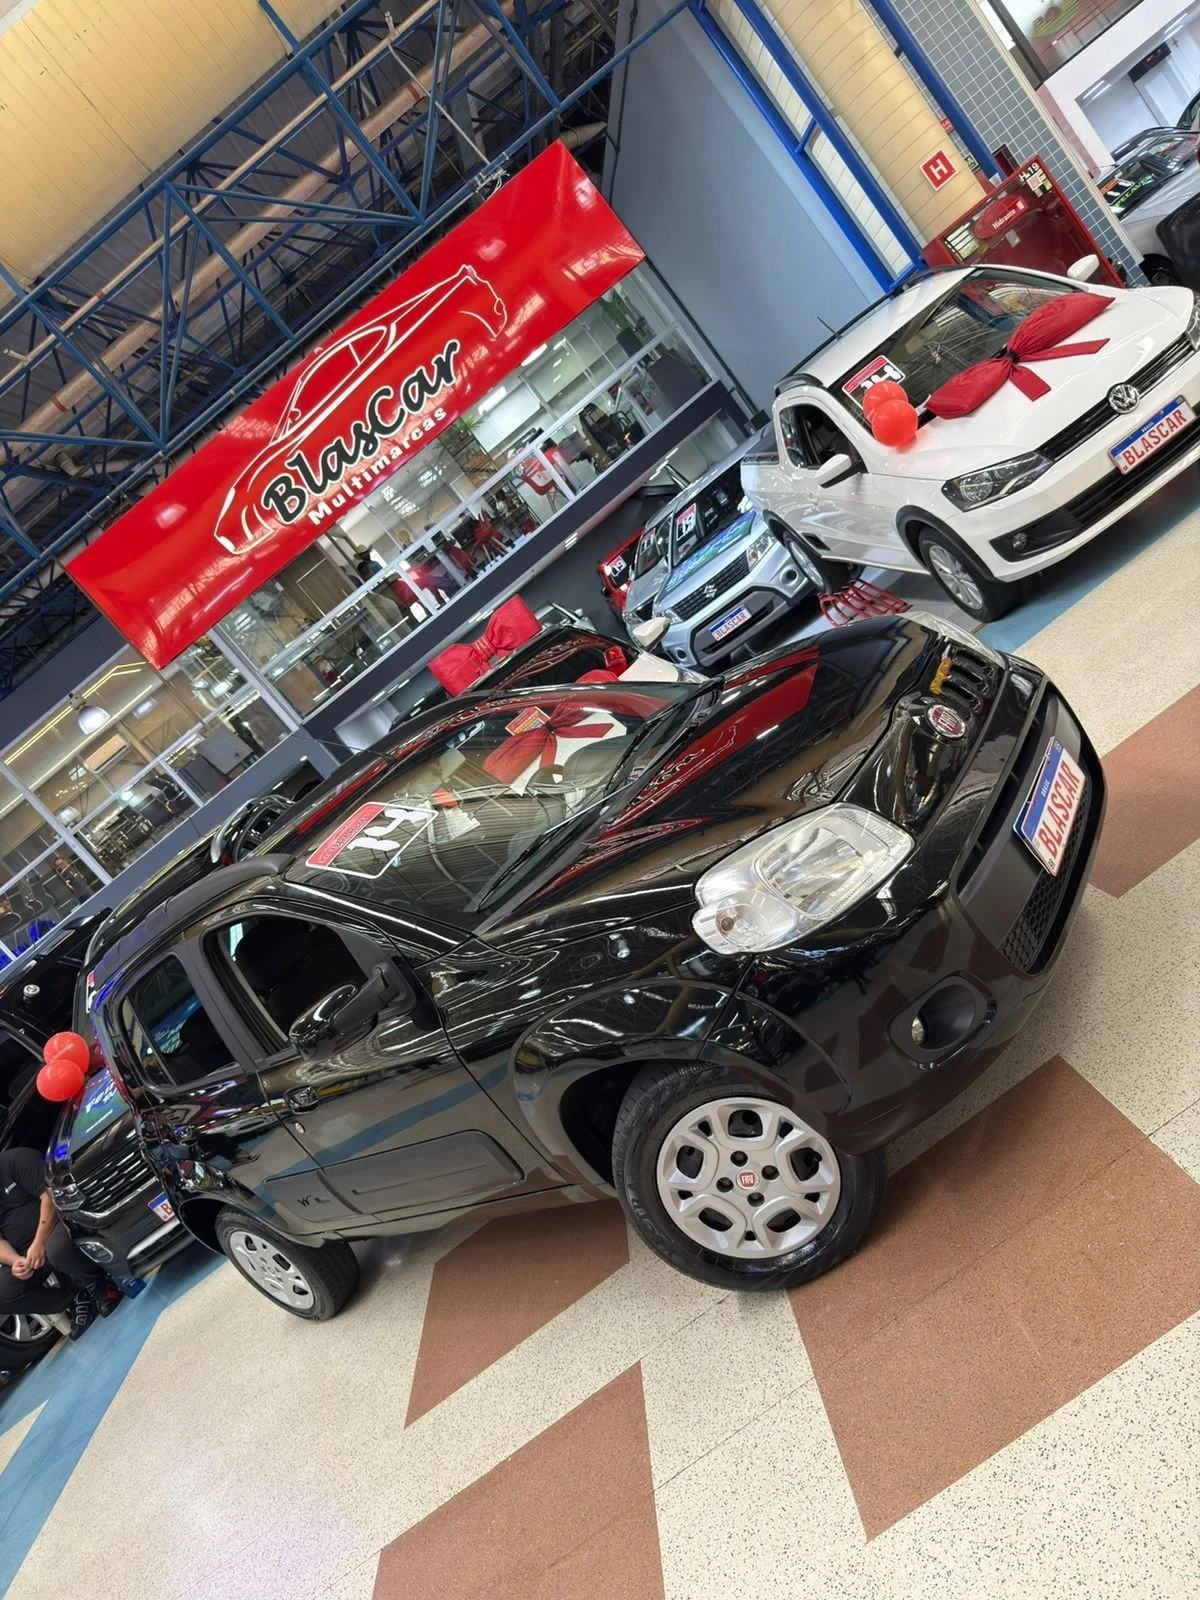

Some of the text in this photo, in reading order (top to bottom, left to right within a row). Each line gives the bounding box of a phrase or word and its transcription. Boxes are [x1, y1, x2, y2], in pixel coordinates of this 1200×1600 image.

[930, 158, 949, 181] H
[992, 208, 1017, 230] Hidrante
[261, 339, 460, 524] BlasCar
[1122, 409, 1188, 466] BLASCAR
[306, 407, 447, 525] Multimarcas
[715, 612, 748, 638] BLASCAR
[937, 711, 958, 732] FIAT
[1037, 761, 1080, 859] BLASCAR
[741, 1174, 755, 1185] FIAT
